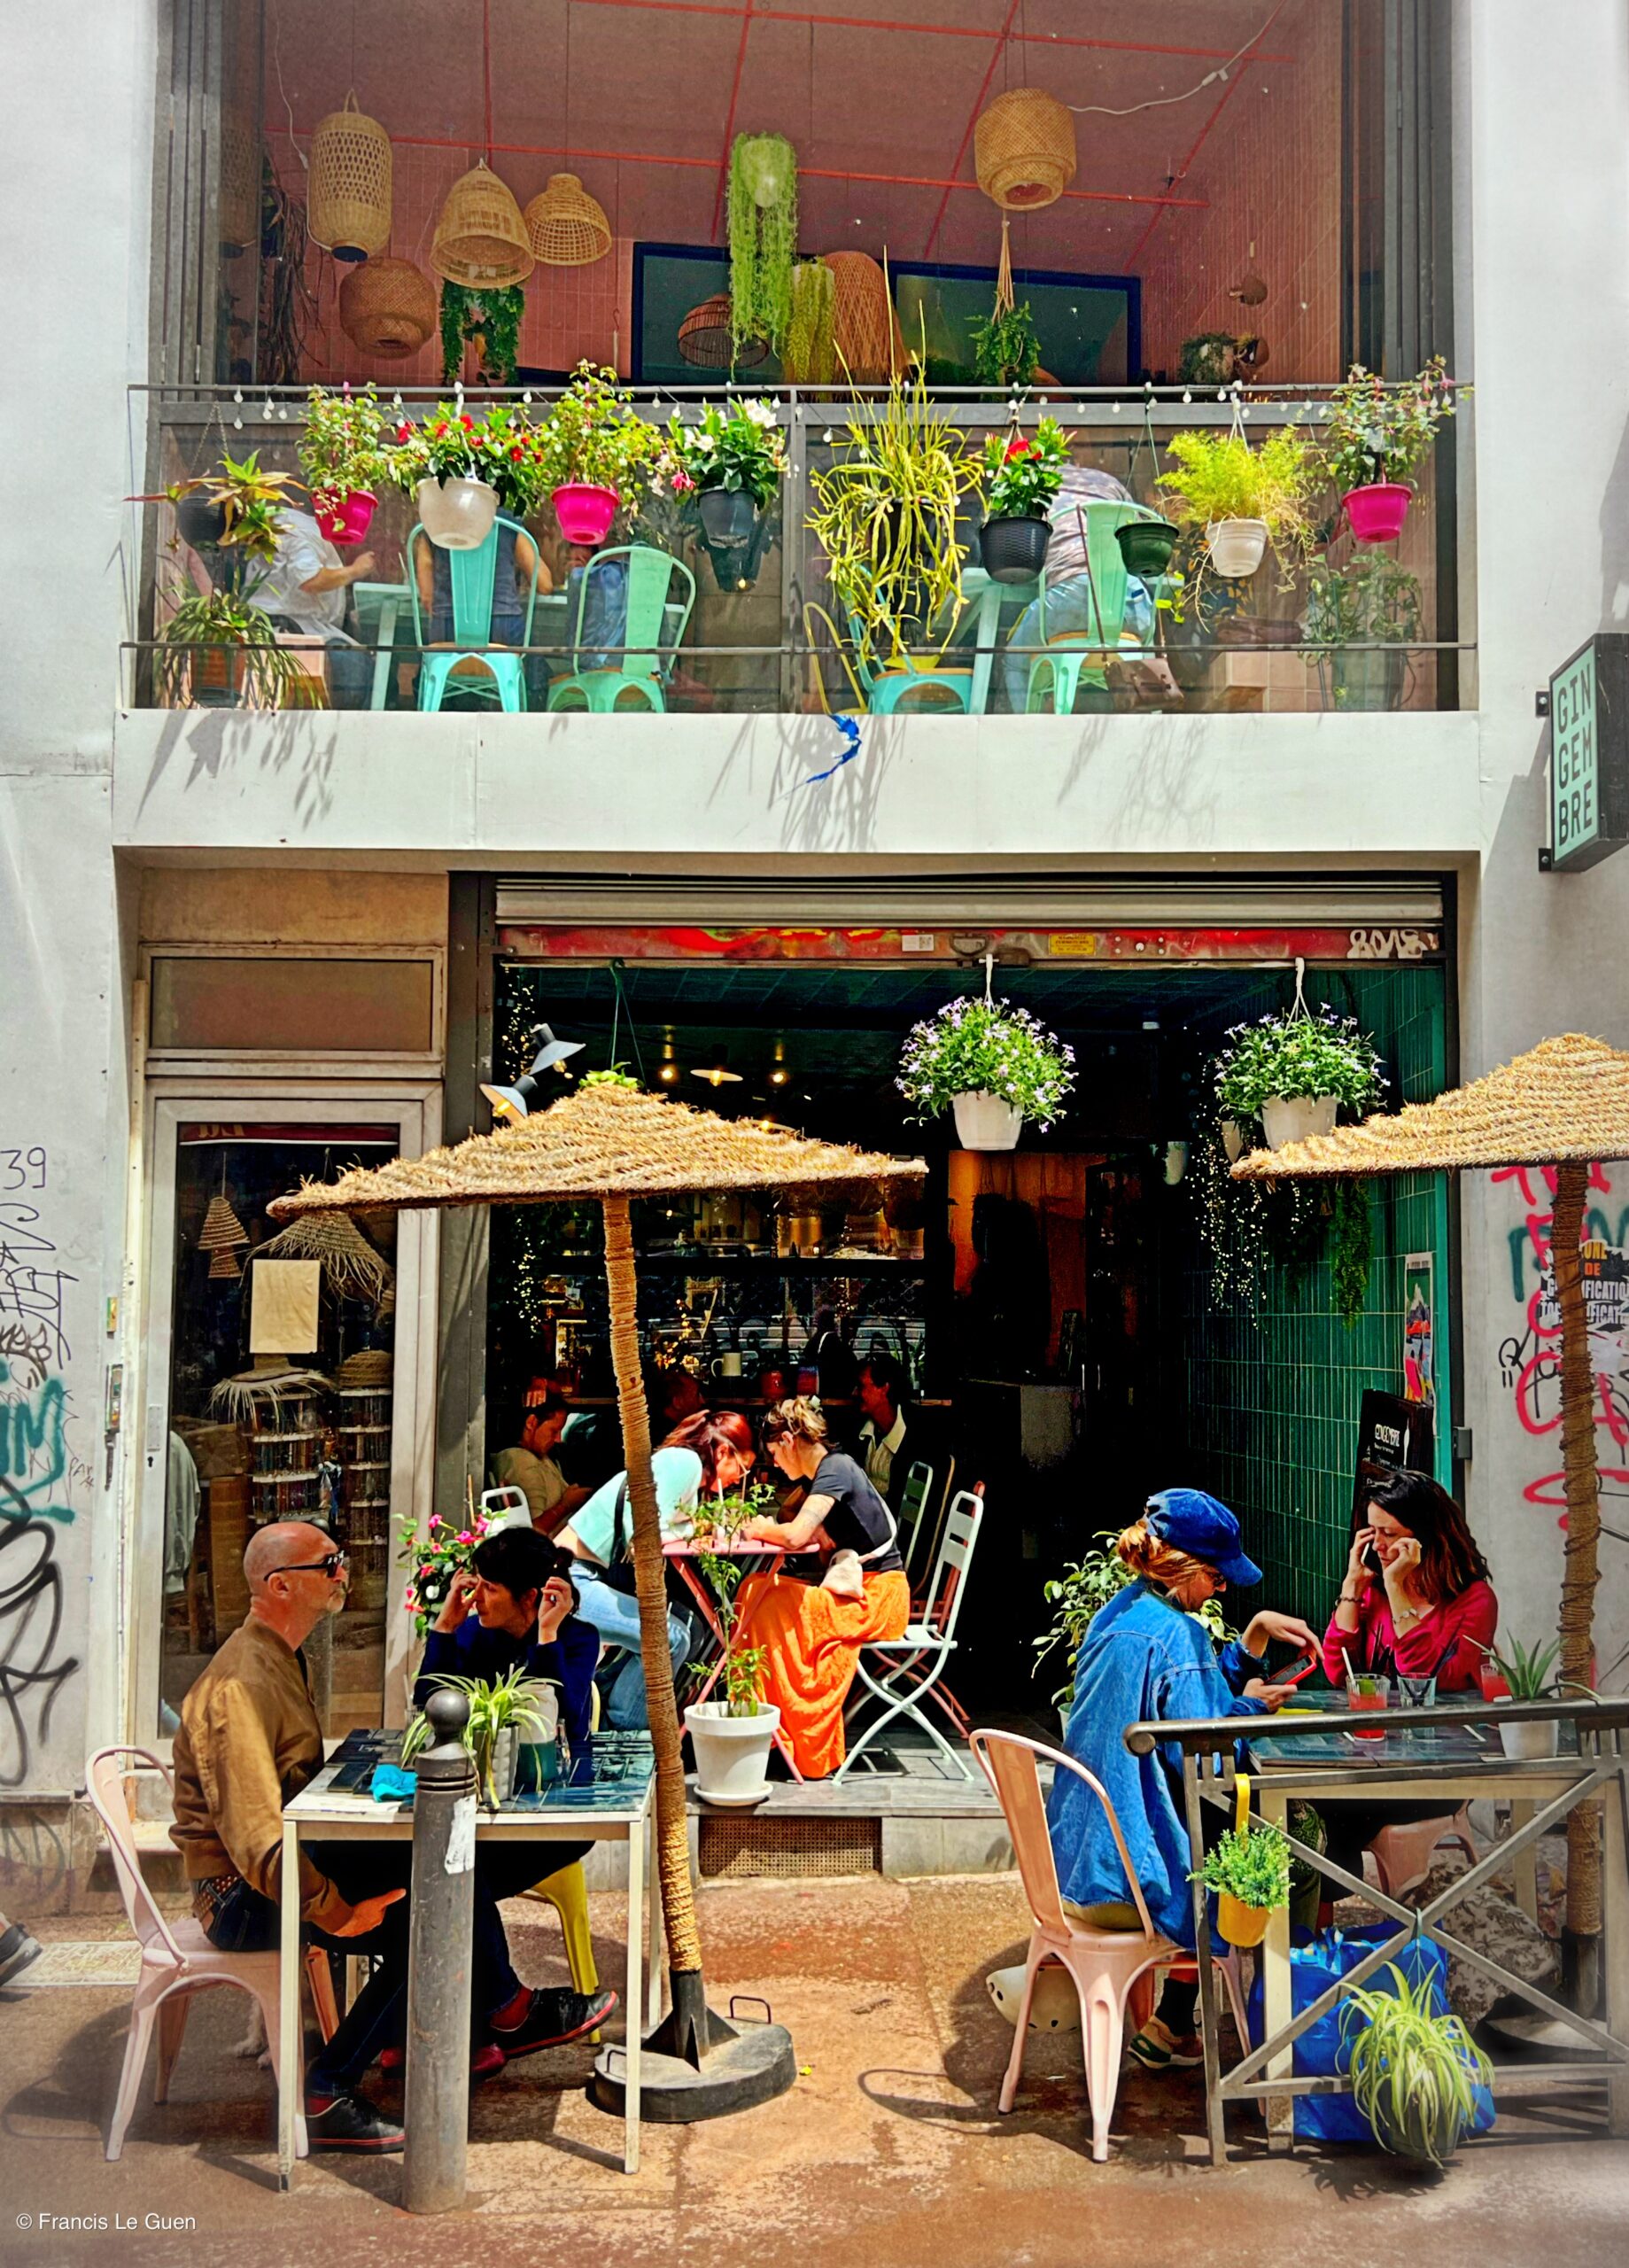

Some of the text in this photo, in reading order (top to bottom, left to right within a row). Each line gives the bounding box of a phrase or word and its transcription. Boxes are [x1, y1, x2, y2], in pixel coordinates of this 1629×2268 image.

[1557, 663, 1592, 734] GIN
[1558, 720, 1593, 790] GEM
[1558, 780, 1593, 847] BRE
[1584, 1262, 1602, 1276] DE
